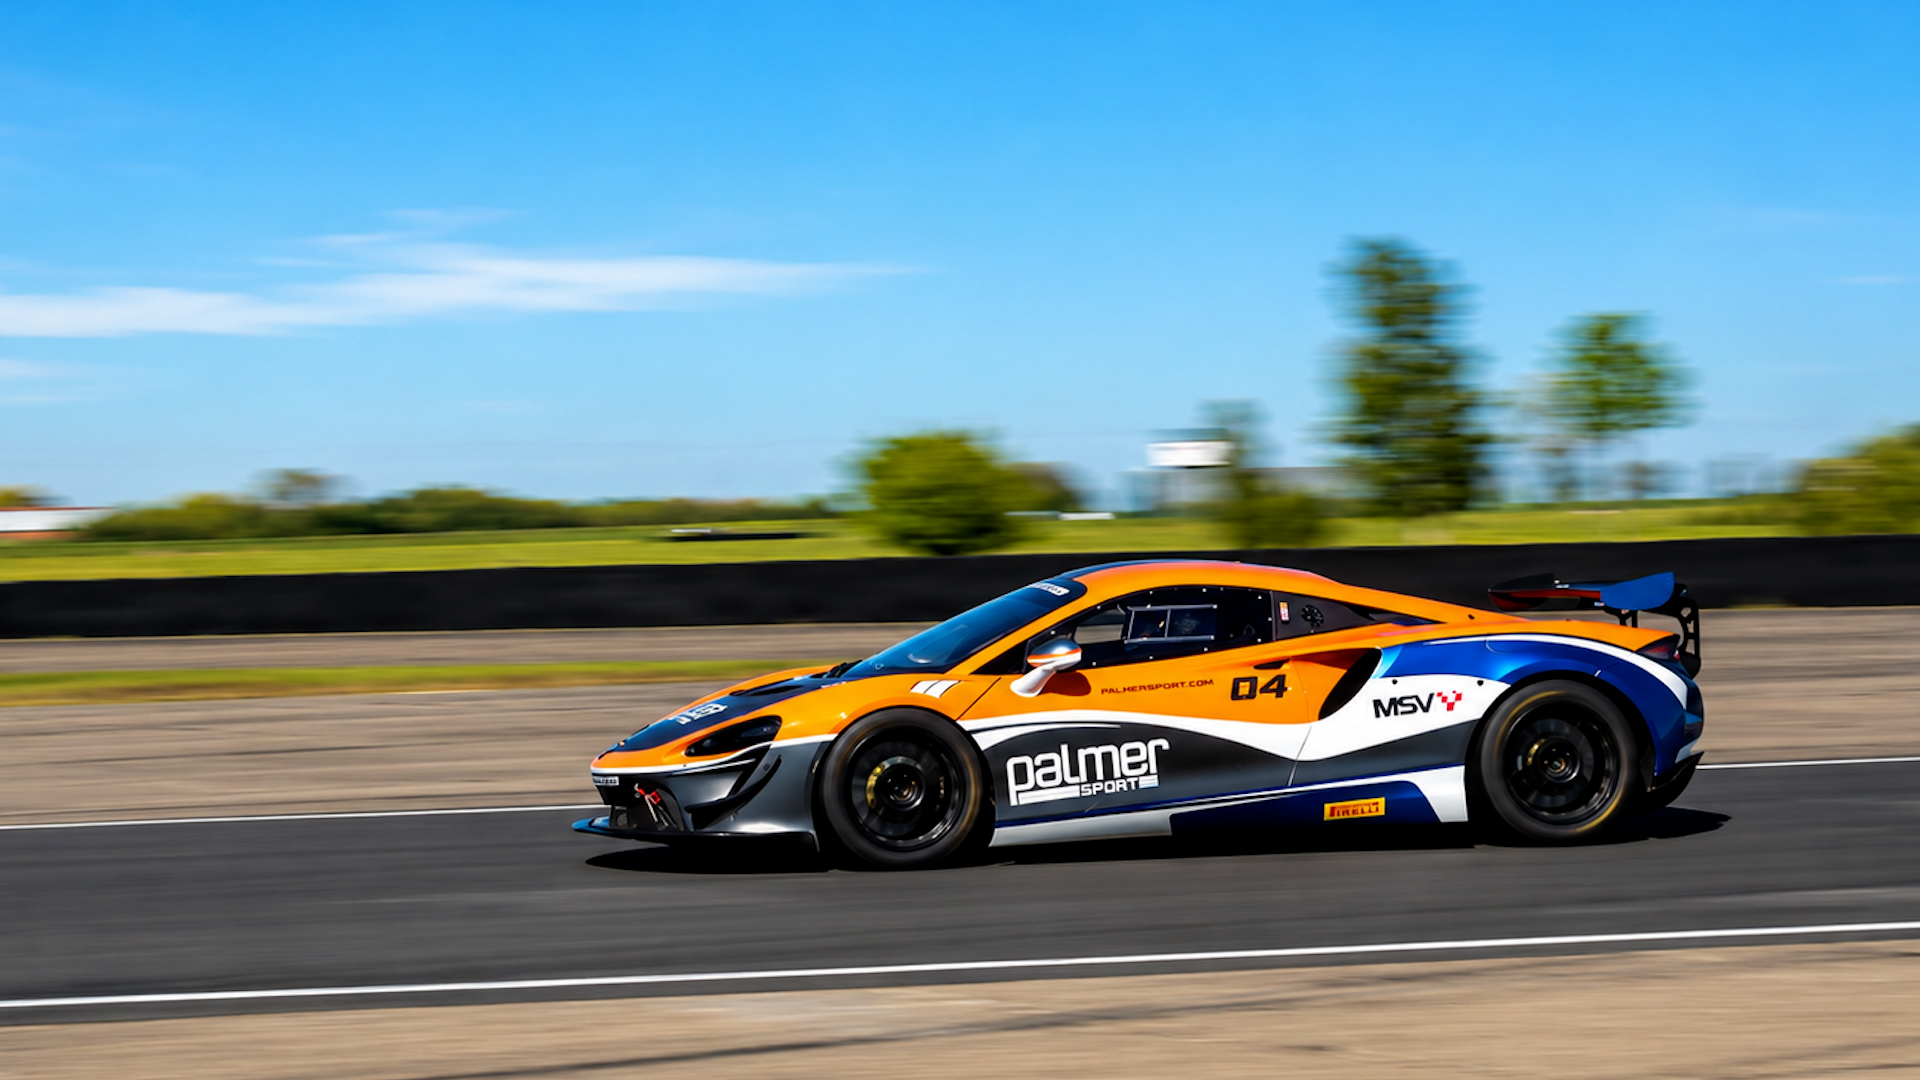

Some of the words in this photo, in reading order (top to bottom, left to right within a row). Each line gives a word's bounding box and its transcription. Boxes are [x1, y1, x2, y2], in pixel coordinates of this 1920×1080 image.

[1101, 679, 1214, 695] PALMERSPORT.COM
[1231, 674, 1287, 700] 04
[1373, 692, 1435, 718] MSV
[1006, 738, 1170, 806] palmer
[1081, 777, 1138, 796] SPORT
[1329, 801, 1379, 817] PIRELLI
